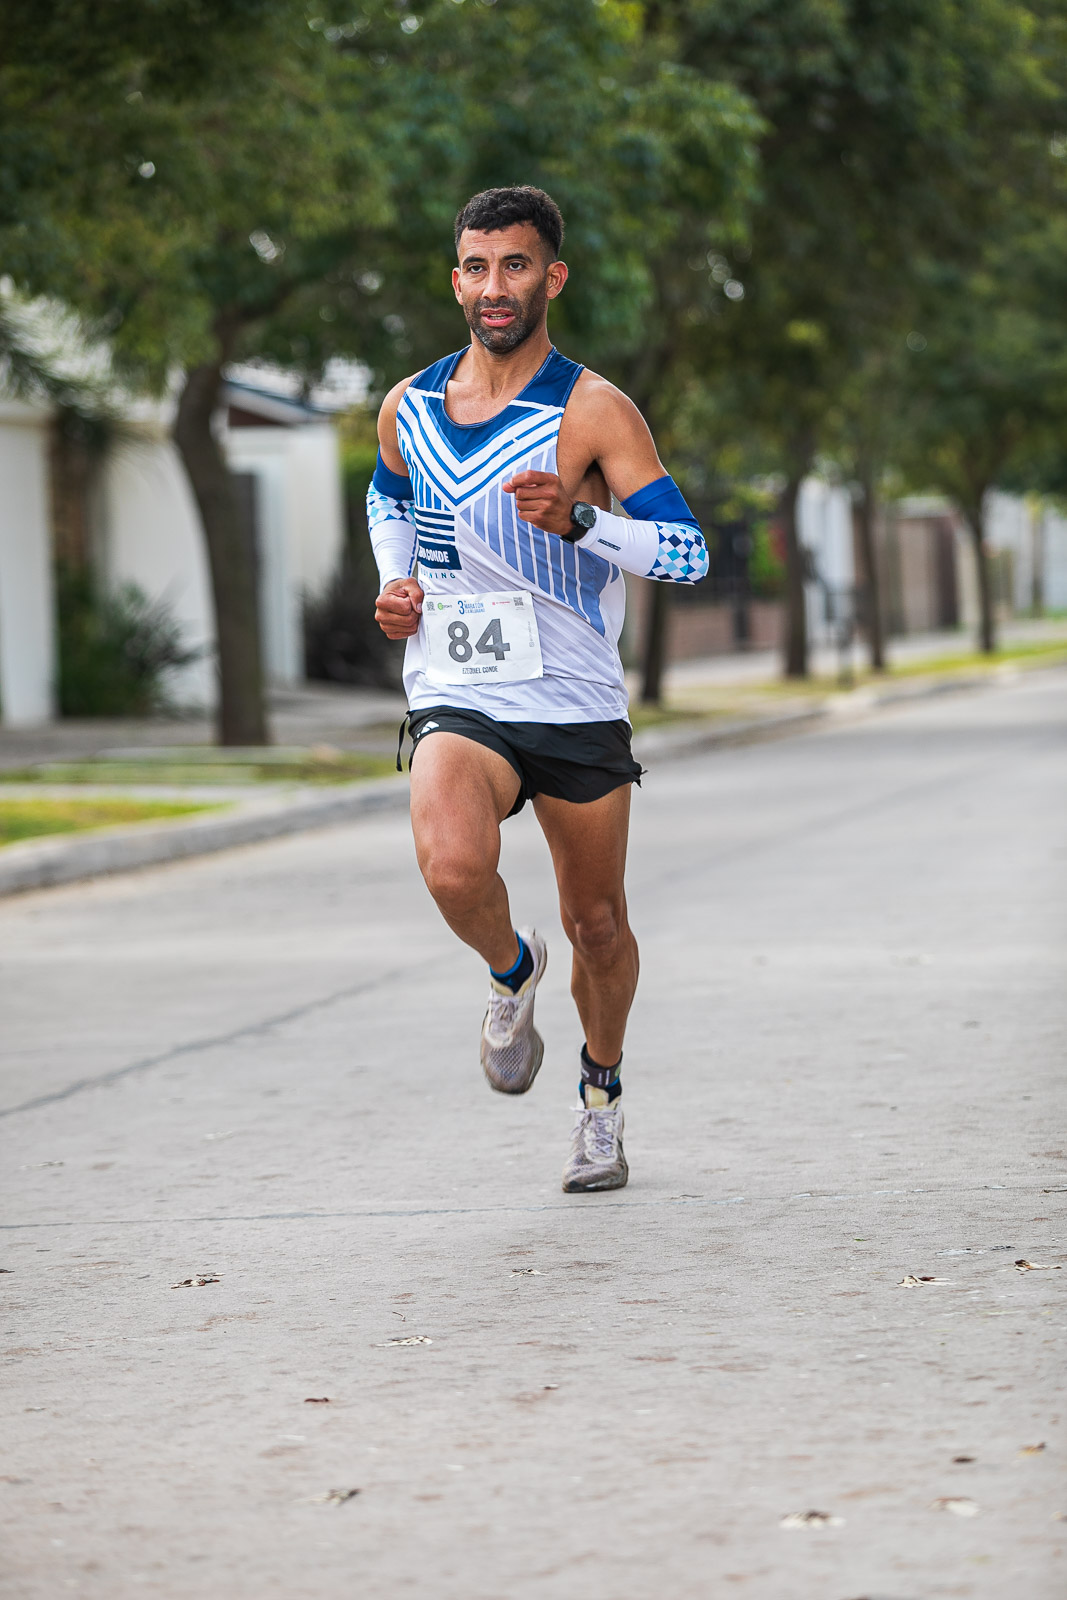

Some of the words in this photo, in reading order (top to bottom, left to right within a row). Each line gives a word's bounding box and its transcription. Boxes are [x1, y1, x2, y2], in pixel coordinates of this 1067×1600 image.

[457, 600, 465, 615] 3
[447, 618, 511, 663] 84
[482, 665, 499, 674] CONDE
